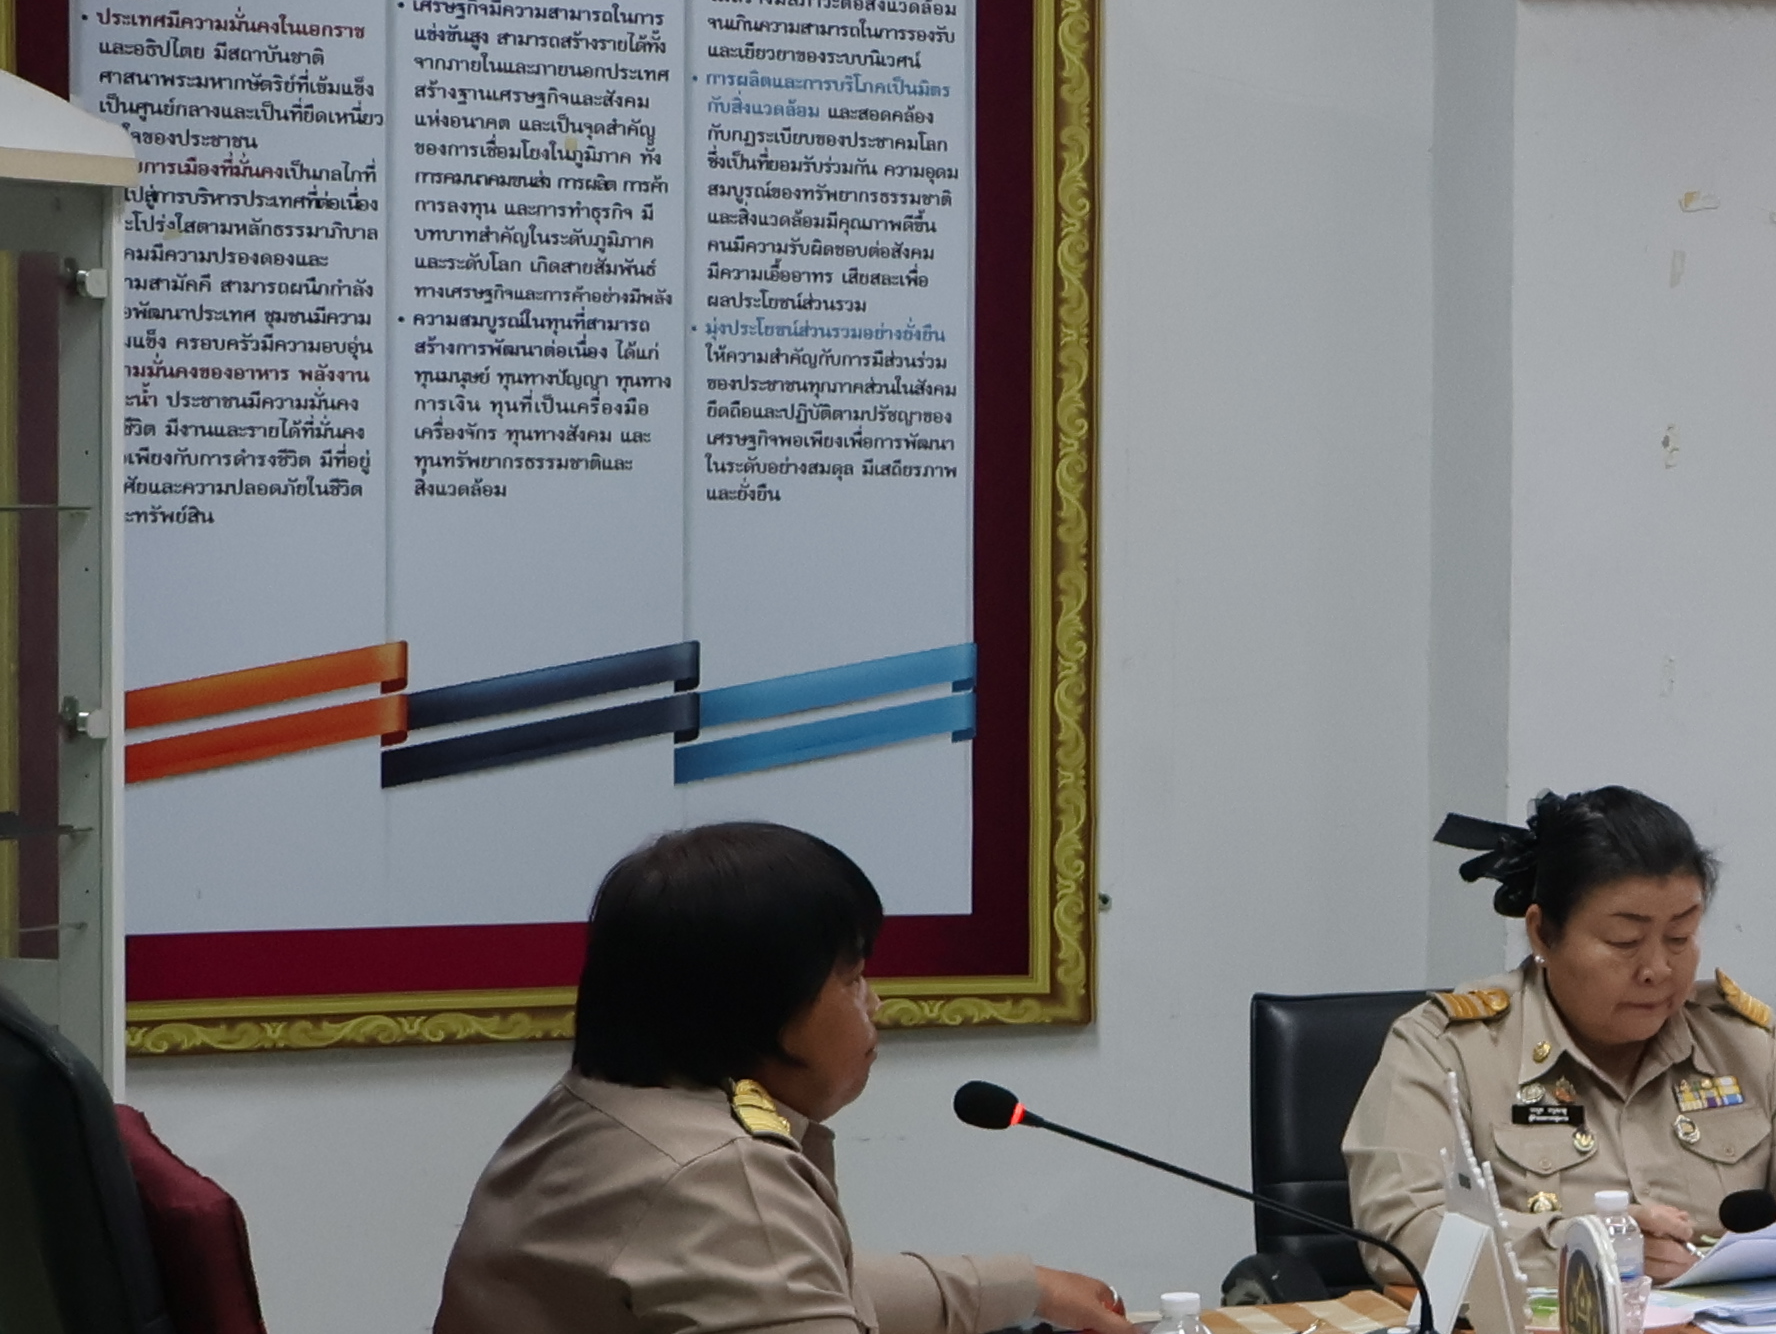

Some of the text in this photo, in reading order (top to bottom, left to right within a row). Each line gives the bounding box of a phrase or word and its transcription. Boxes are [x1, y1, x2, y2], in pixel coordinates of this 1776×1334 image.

[96, 7, 365, 39] ประเทศมีความมั่นคงในเอกราช
[414, 52, 669, 82] จากภายในและภายนอกประเทศ
[414, 79, 649, 109] สร้างฐานเศรษฐกิจและสังคม
[414, 109, 510, 130] แห่งอนาคต
[414, 199, 496, 219] การลงทุน
[641, 203, 654, 220] มี
[414, 251, 521, 272] และระดับโลก
[616, 339, 659, 360] ได้แก่
[299, 365, 370, 383] พลังงาน
[616, 373, 671, 392] ทุนทาง
[167, 386, 359, 411] ประชาชนมีความมั่นคง
[414, 394, 480, 413] การเงิน
[506, 424, 611, 447] ทุนทางสังคม
[621, 429, 650, 443] และ
